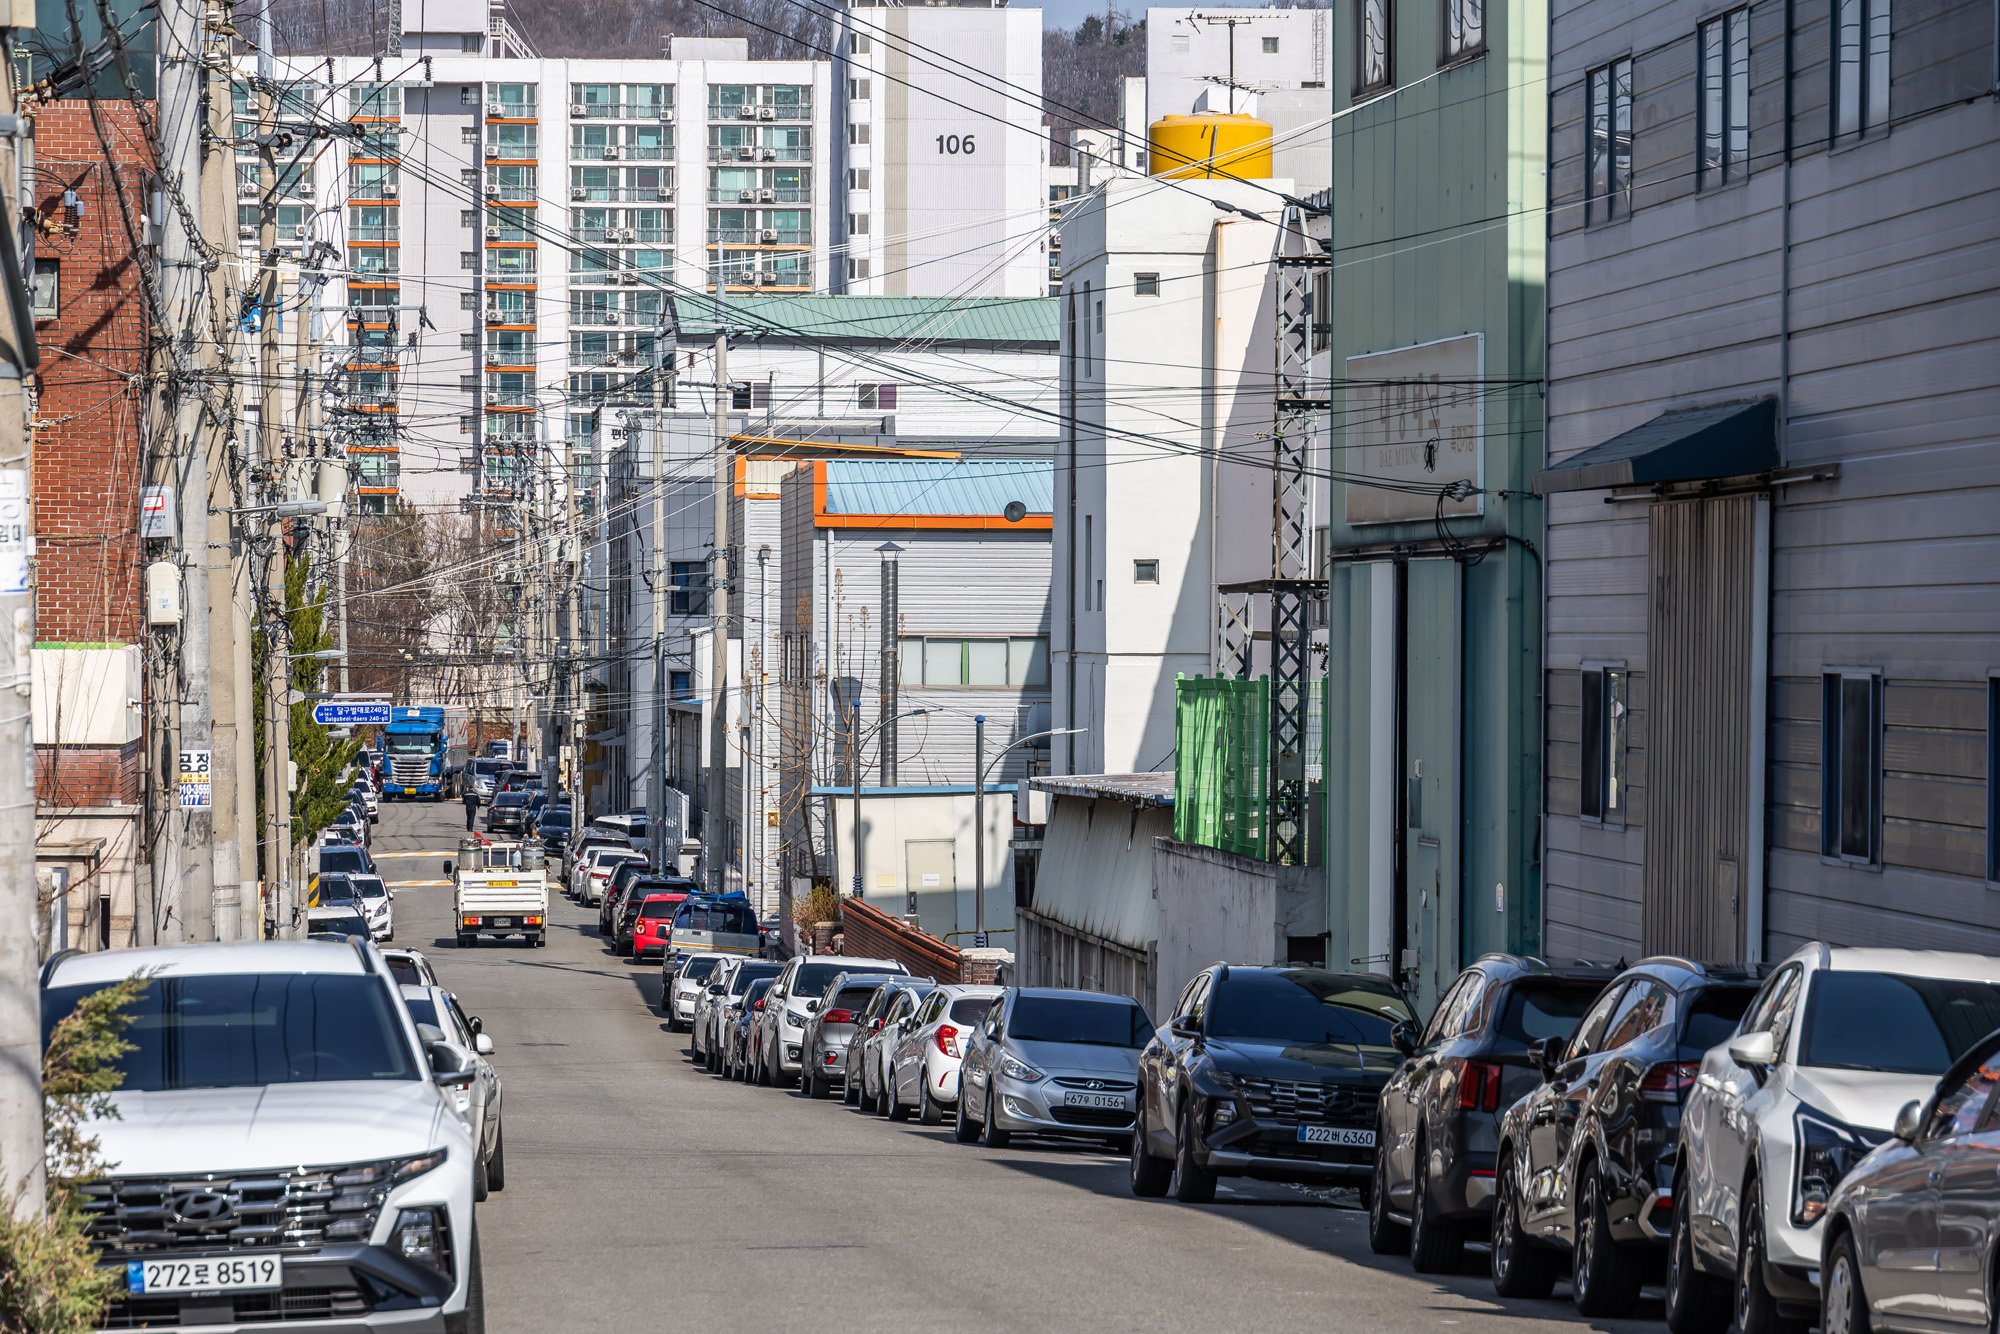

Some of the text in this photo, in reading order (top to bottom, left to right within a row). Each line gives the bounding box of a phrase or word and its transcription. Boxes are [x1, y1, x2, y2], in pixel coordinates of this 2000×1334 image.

[936, 134, 976, 155] 106
[1379, 449, 1393, 468] DAE
[336, 706, 389, 716] 달구벌대로240길
[179, 752, 209, 773] 공장
[180, 794, 200, 805] 1177
[1070, 1094, 1120, 1108] 67우 0156
[1307, 1127, 1373, 1145] 222버 6360
[148, 1259, 275, 1288] 272로 8519
